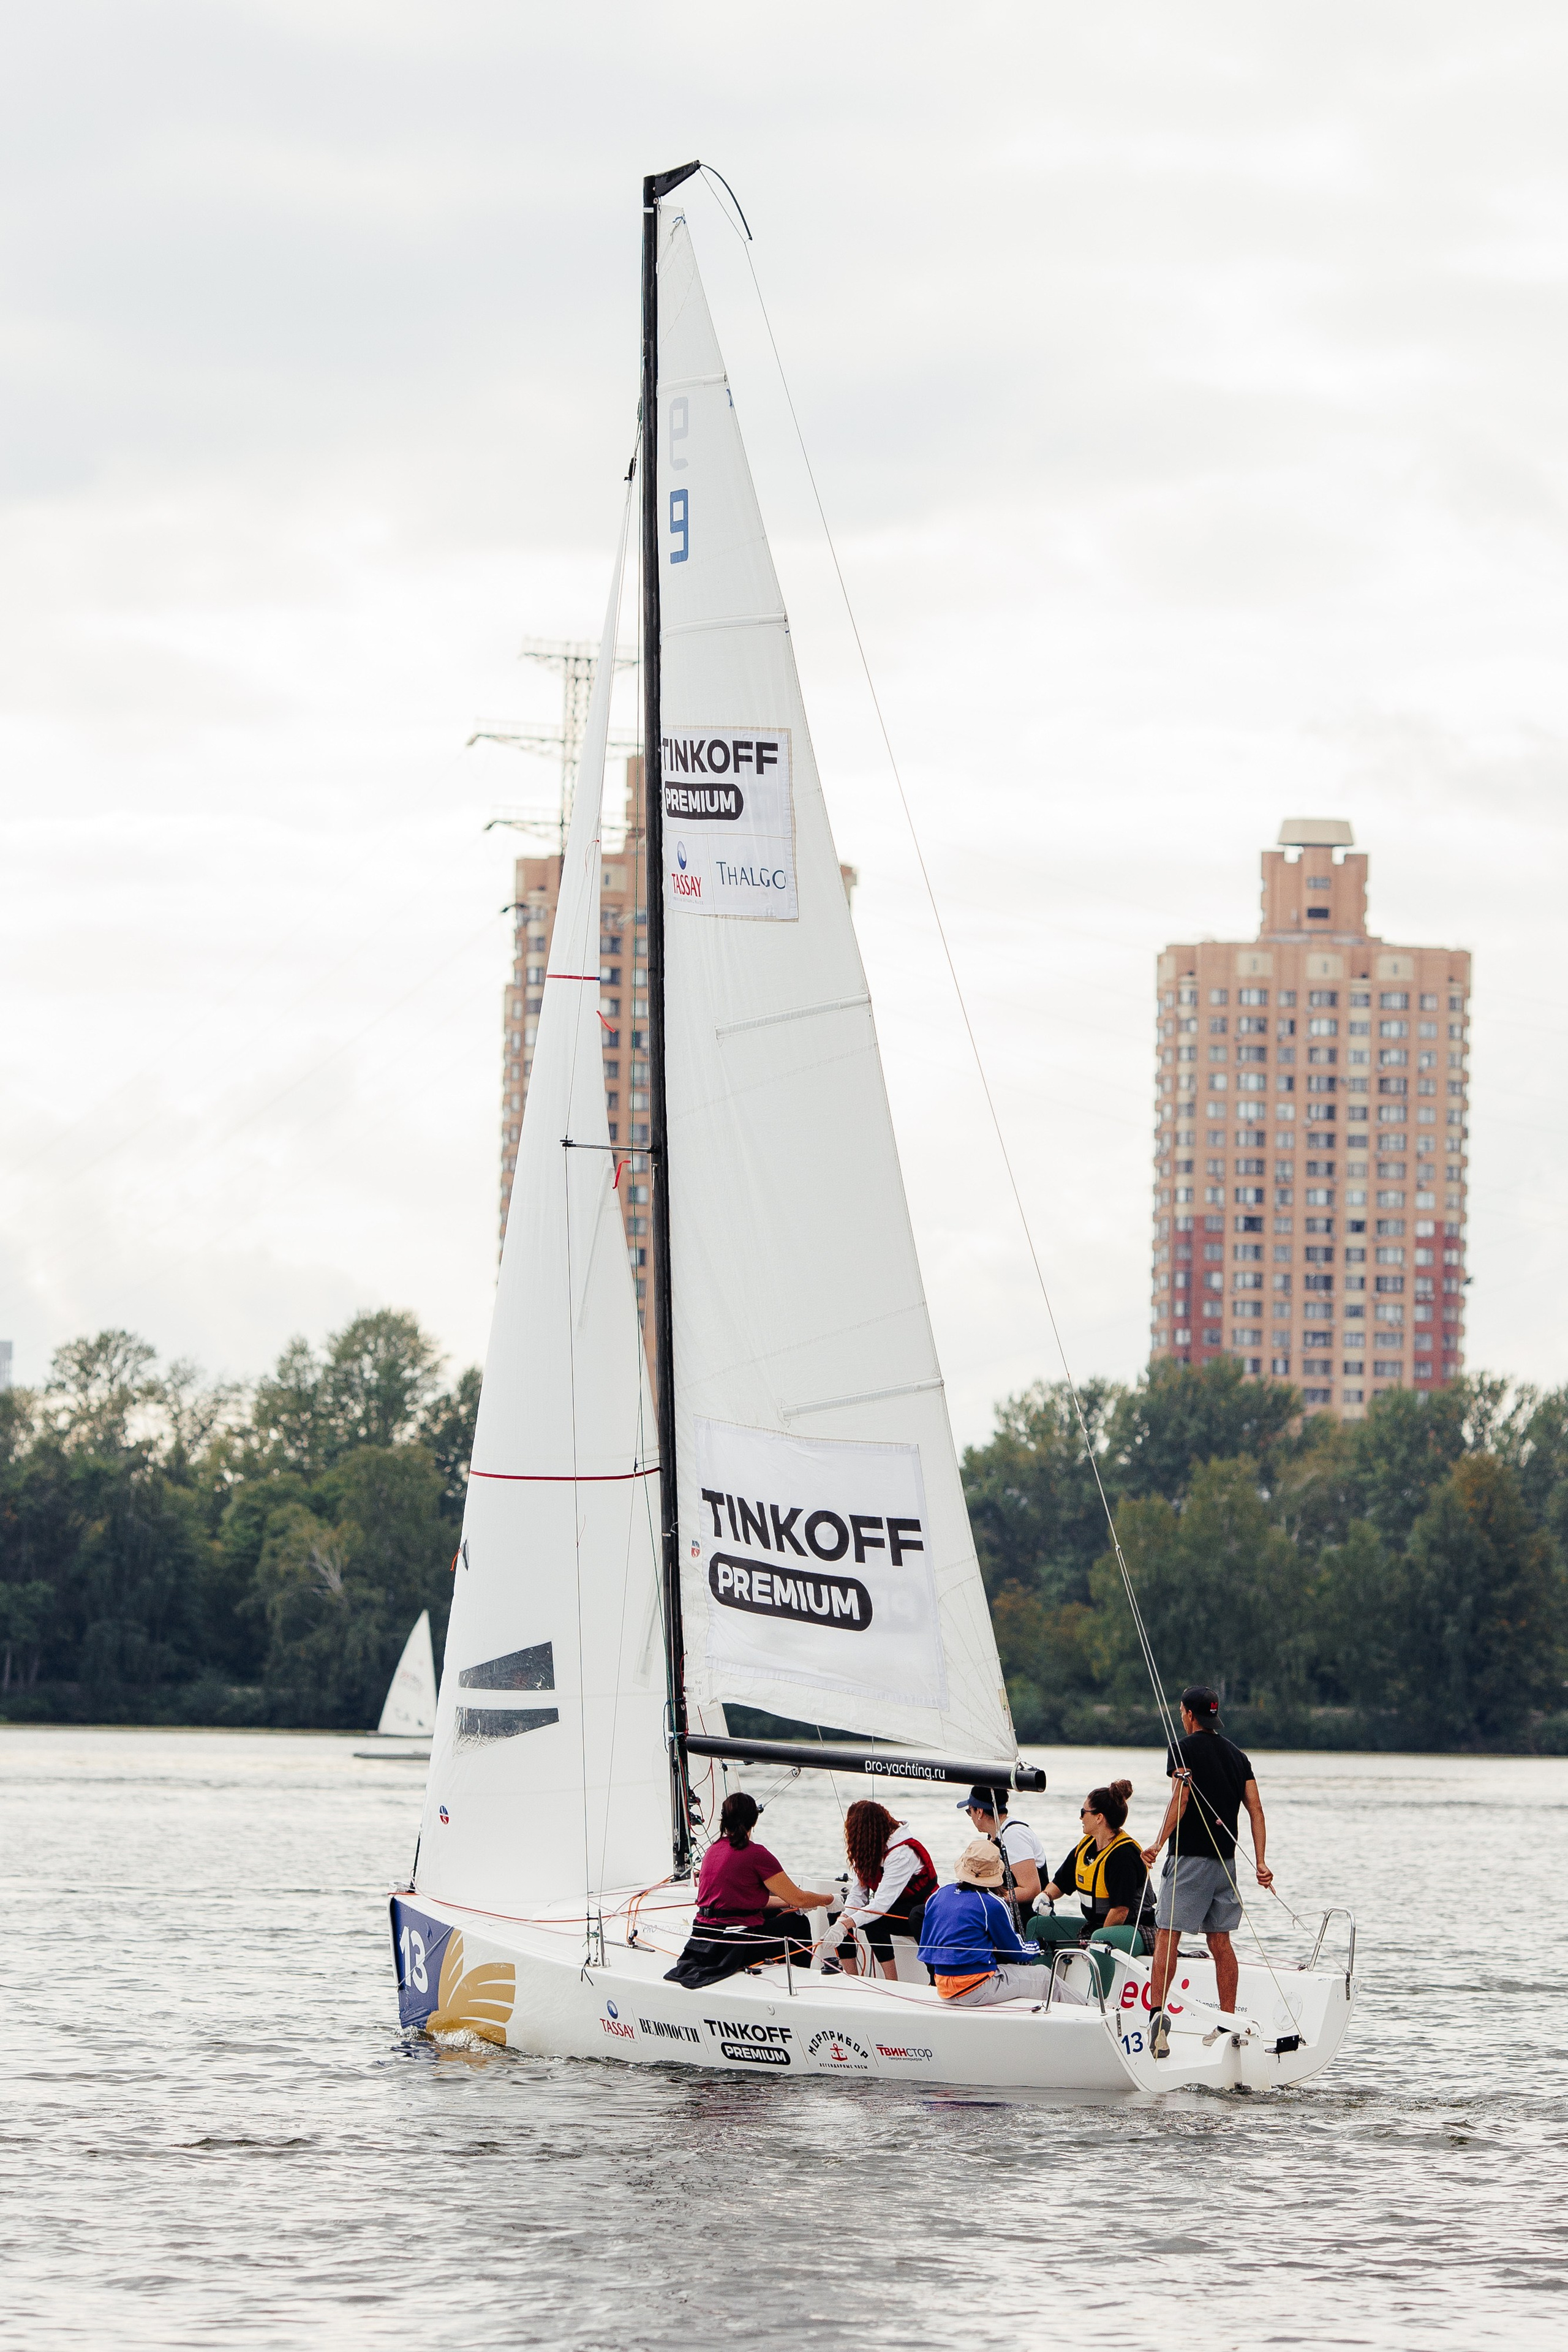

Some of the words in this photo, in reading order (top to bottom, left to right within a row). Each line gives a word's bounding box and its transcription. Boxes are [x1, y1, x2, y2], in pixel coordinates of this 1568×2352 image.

[669, 489, 688, 564] 9
[662, 737, 778, 775] TINKOFF
[665, 788, 736, 813] PREMIUM
[671, 873, 701, 897] TASSAY
[701, 1488, 924, 1567] TINKOFF
[717, 1562, 860, 1621] PREMIUM
[865, 1759, 945, 1781] pro-yachting.ru
[399, 1926, 428, 1994] 13
[600, 2018, 635, 2039] TASSAY
[638, 2018, 701, 2043] ВЕДОМОСТИ
[703, 2019, 793, 2044] TINKOFF
[725, 2046, 786, 2062] PREMIUM
[808, 2030, 869, 2059] МОРПРИБОР
[1121, 2032, 1144, 2055] 13
